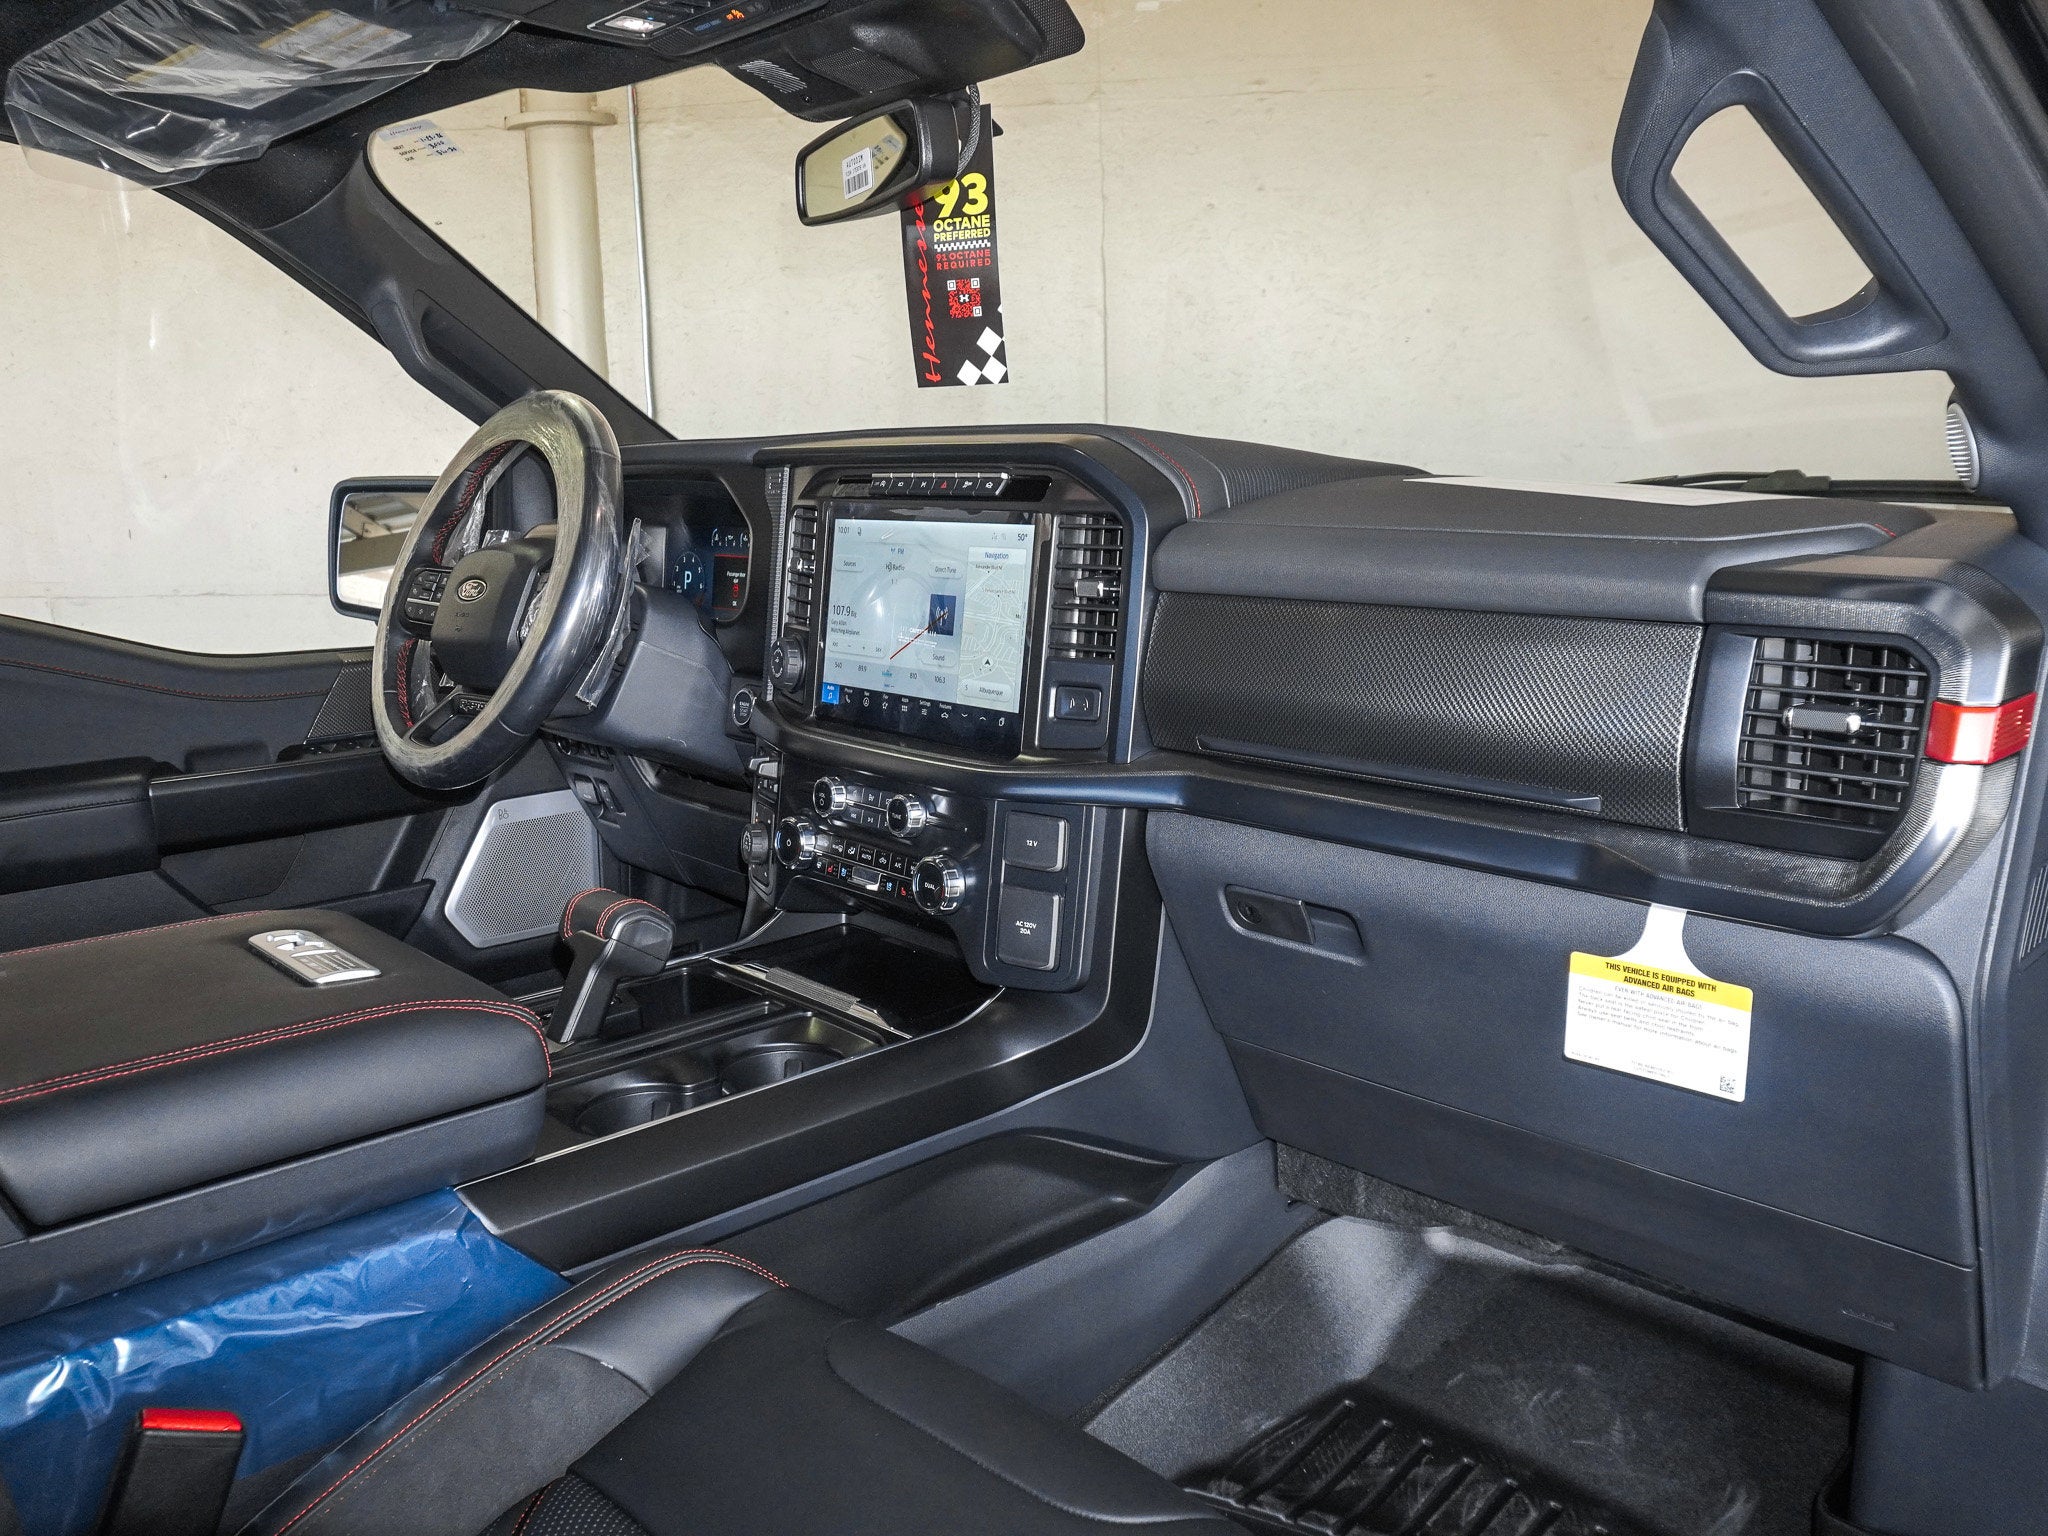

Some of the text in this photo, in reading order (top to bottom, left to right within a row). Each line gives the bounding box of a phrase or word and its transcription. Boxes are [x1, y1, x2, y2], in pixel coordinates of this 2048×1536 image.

[933, 172, 989, 219] 93
[933, 214, 990, 232] OCTANE
[933, 227, 991, 242] PREFERRED
[935, 249, 991, 262] 91 OCTANE
[936, 258, 992, 271] REQUIRED
[914, 203, 942, 383] Hennesse
[984, 551, 1009, 561] Navigation
[684, 570, 692, 590] P
[832, 604, 851, 617] 107.9
[1605, 962, 1717, 992] THIS VEHICLE IS EQUIPPED WITH
[1623, 975, 1696, 998] ADVANCED AIR BAGS
